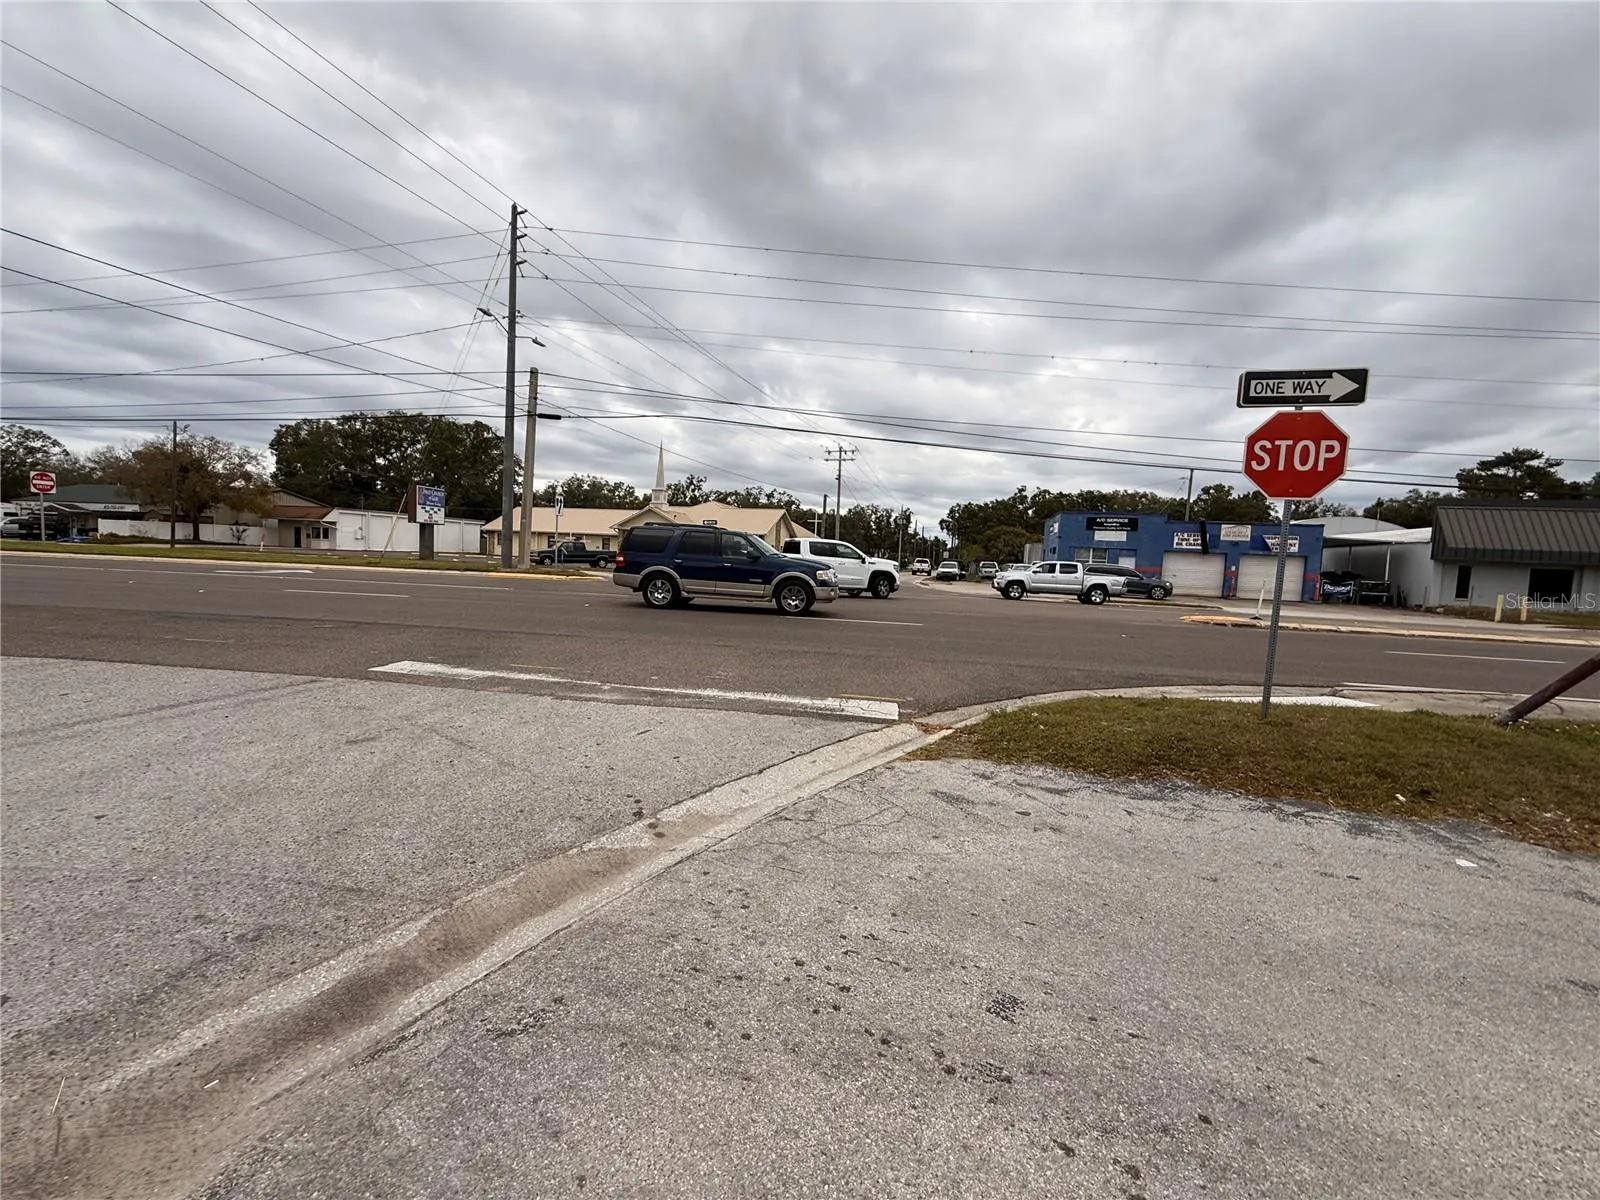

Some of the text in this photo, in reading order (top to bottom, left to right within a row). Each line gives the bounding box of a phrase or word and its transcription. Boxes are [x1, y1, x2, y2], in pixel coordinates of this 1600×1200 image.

[1253, 380, 1327, 395] ONE WAY
[1250, 439, 1341, 472] STOP
